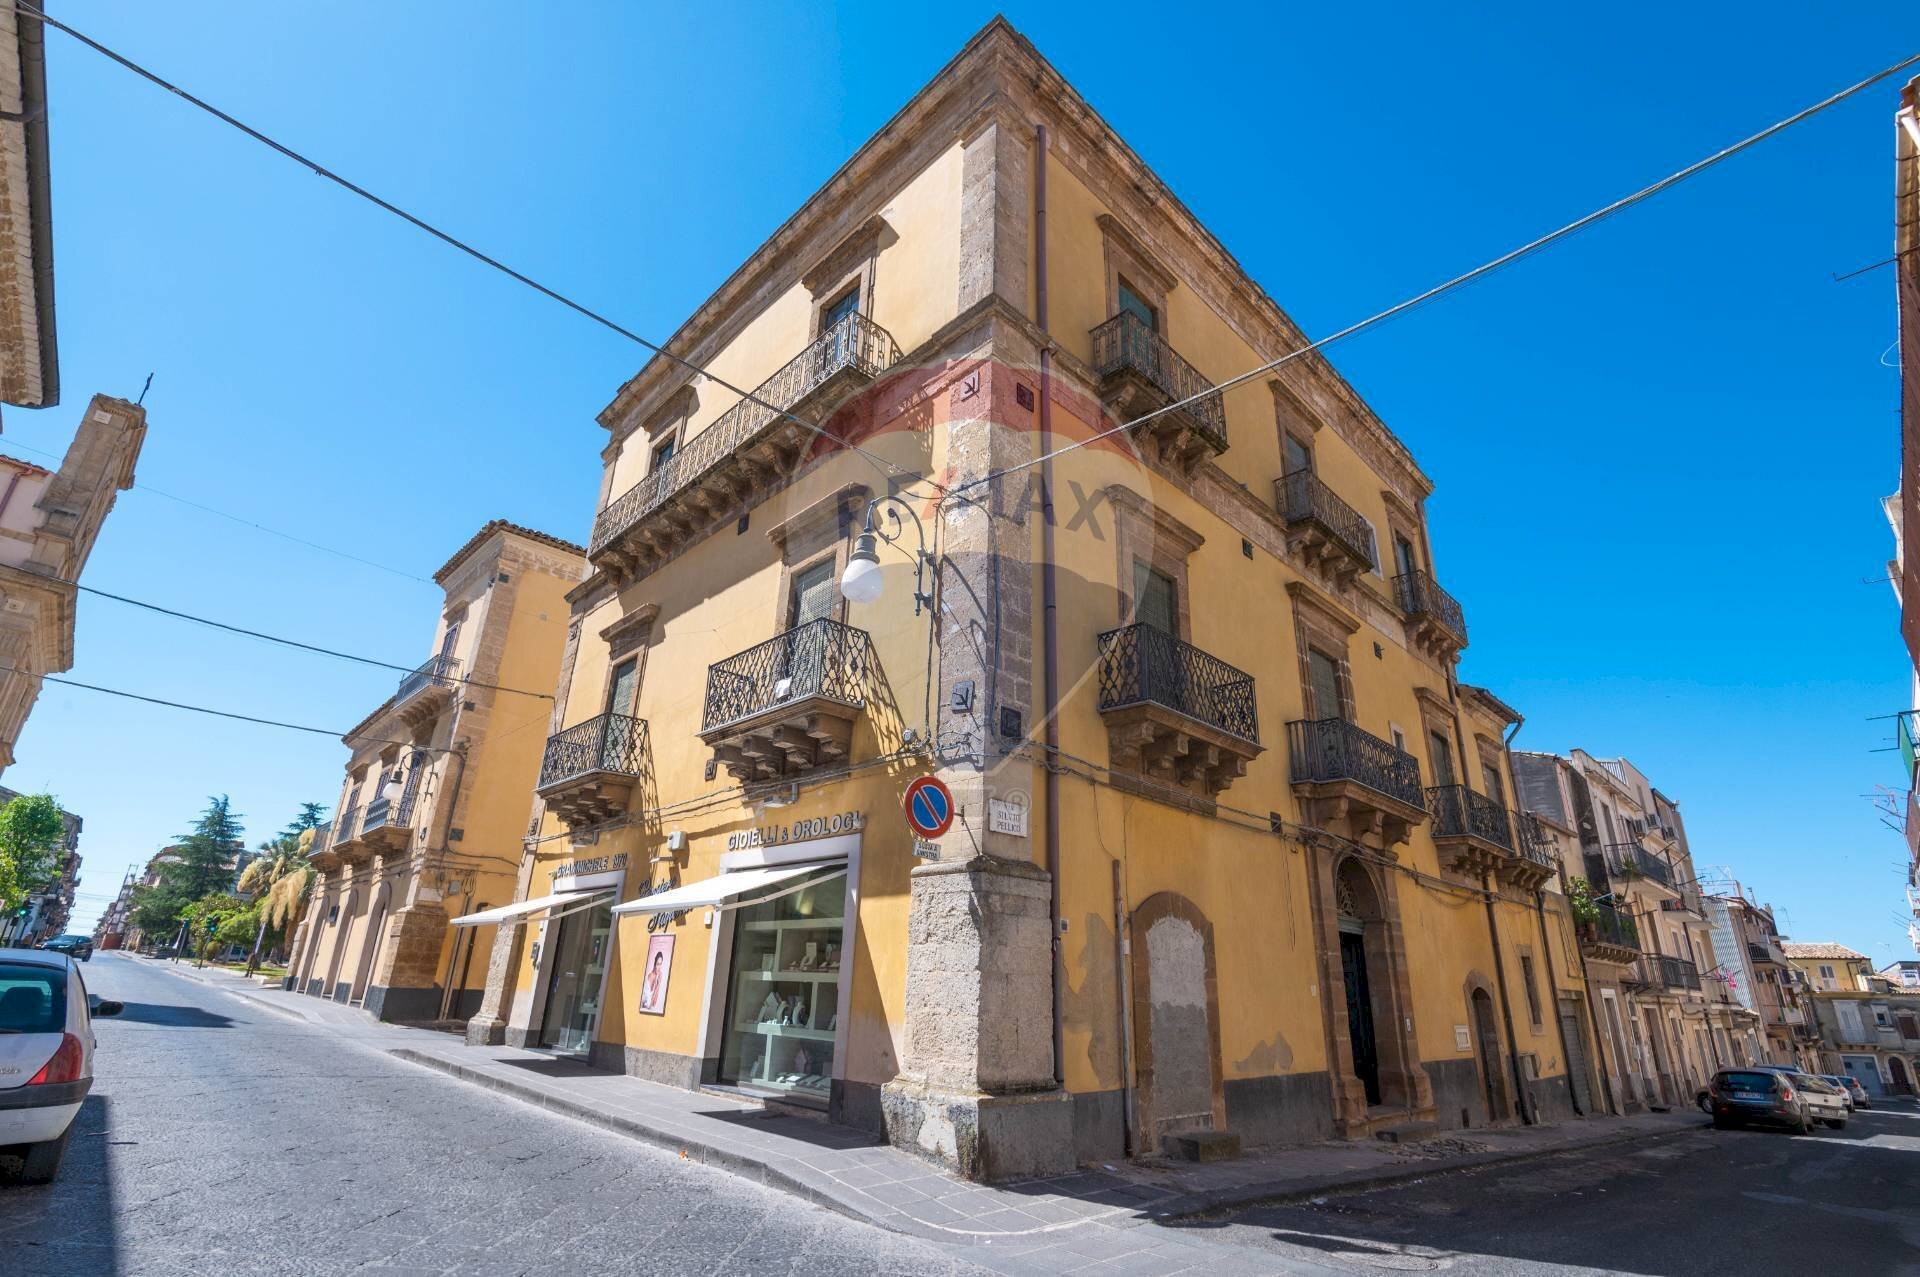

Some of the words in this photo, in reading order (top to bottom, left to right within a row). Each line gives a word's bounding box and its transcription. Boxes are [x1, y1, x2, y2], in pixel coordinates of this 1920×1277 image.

[998, 811, 1020, 821] SILVIO
[996, 821, 1021, 833] PELLICO
[728, 824, 779, 851] GIOIELLI
[781, 827, 789, 842] &
